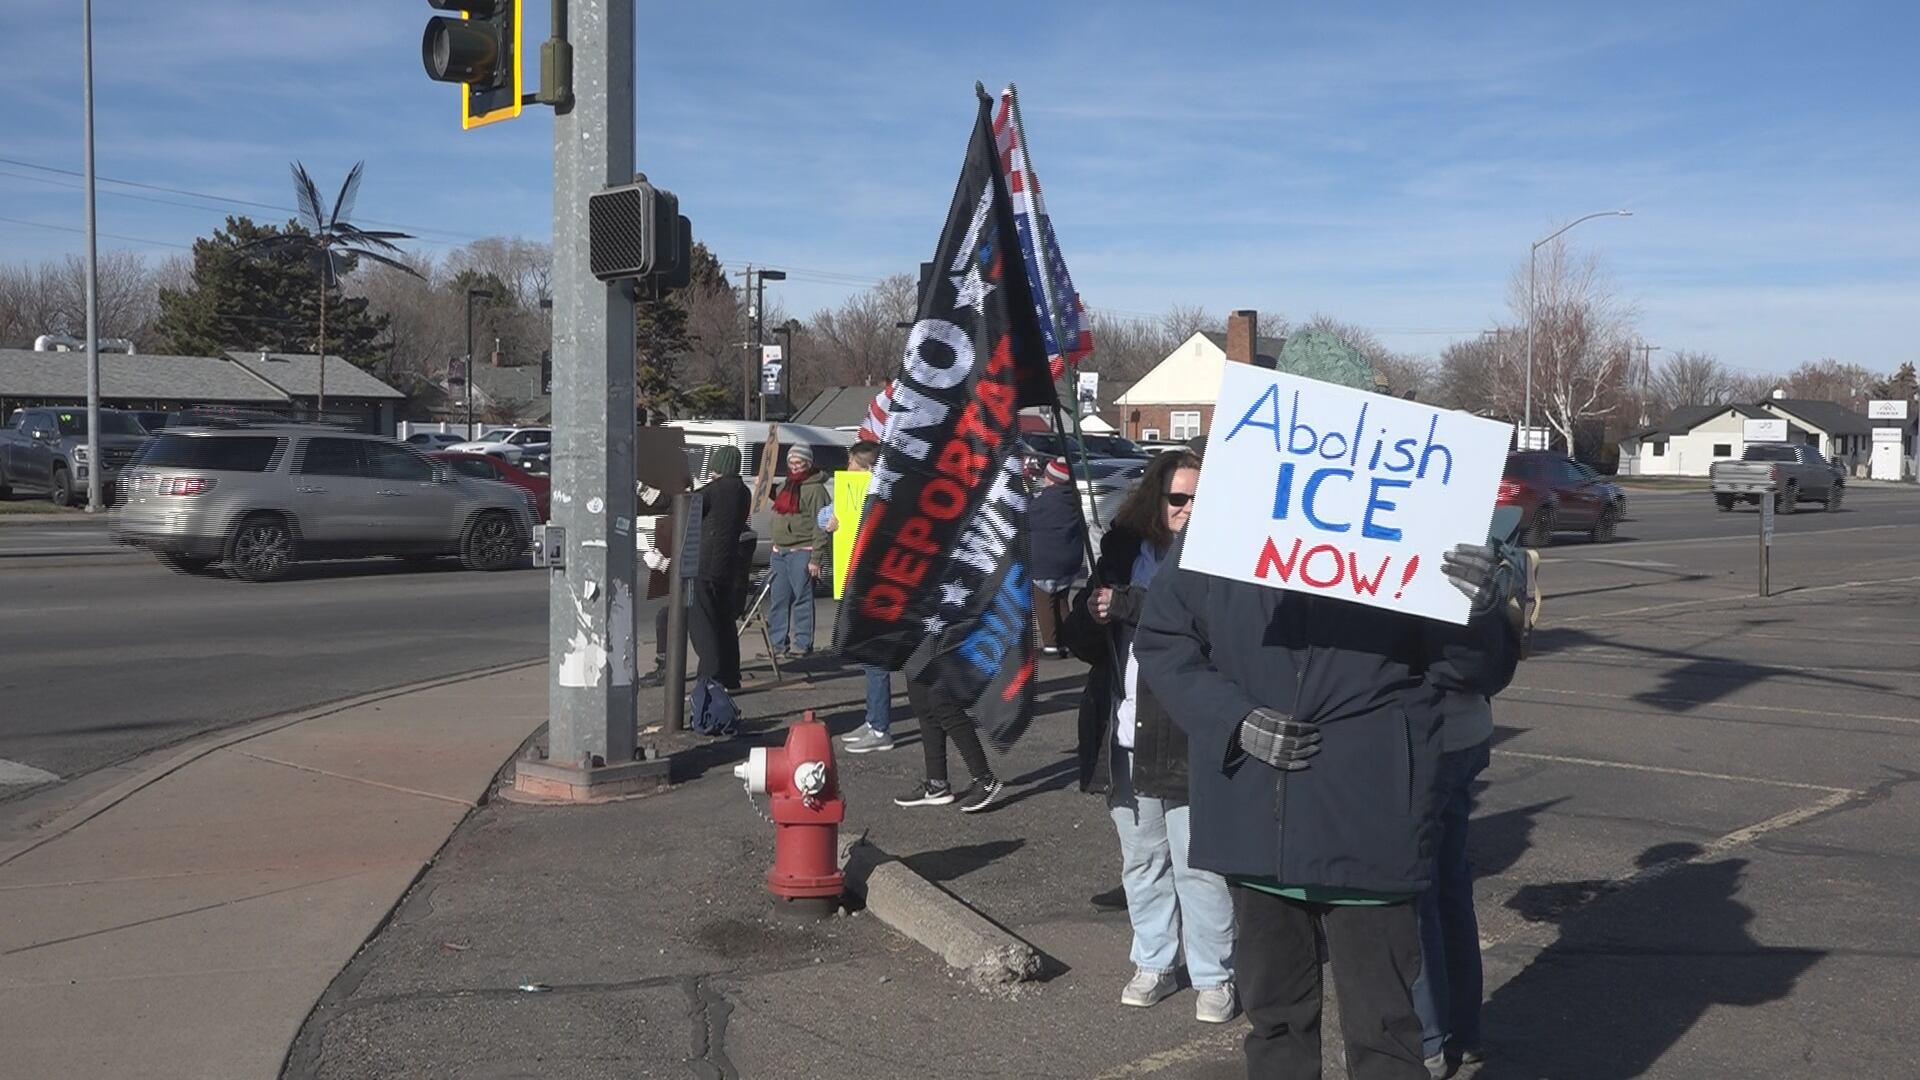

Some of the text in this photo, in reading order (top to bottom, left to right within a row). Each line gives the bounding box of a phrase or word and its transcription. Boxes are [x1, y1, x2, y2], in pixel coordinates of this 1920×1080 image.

[881, 320, 976, 460] NO
[1226, 384, 1453, 485] Abolish
[1273, 463, 1412, 542] ICE
[1255, 536, 1420, 599] NOW!
